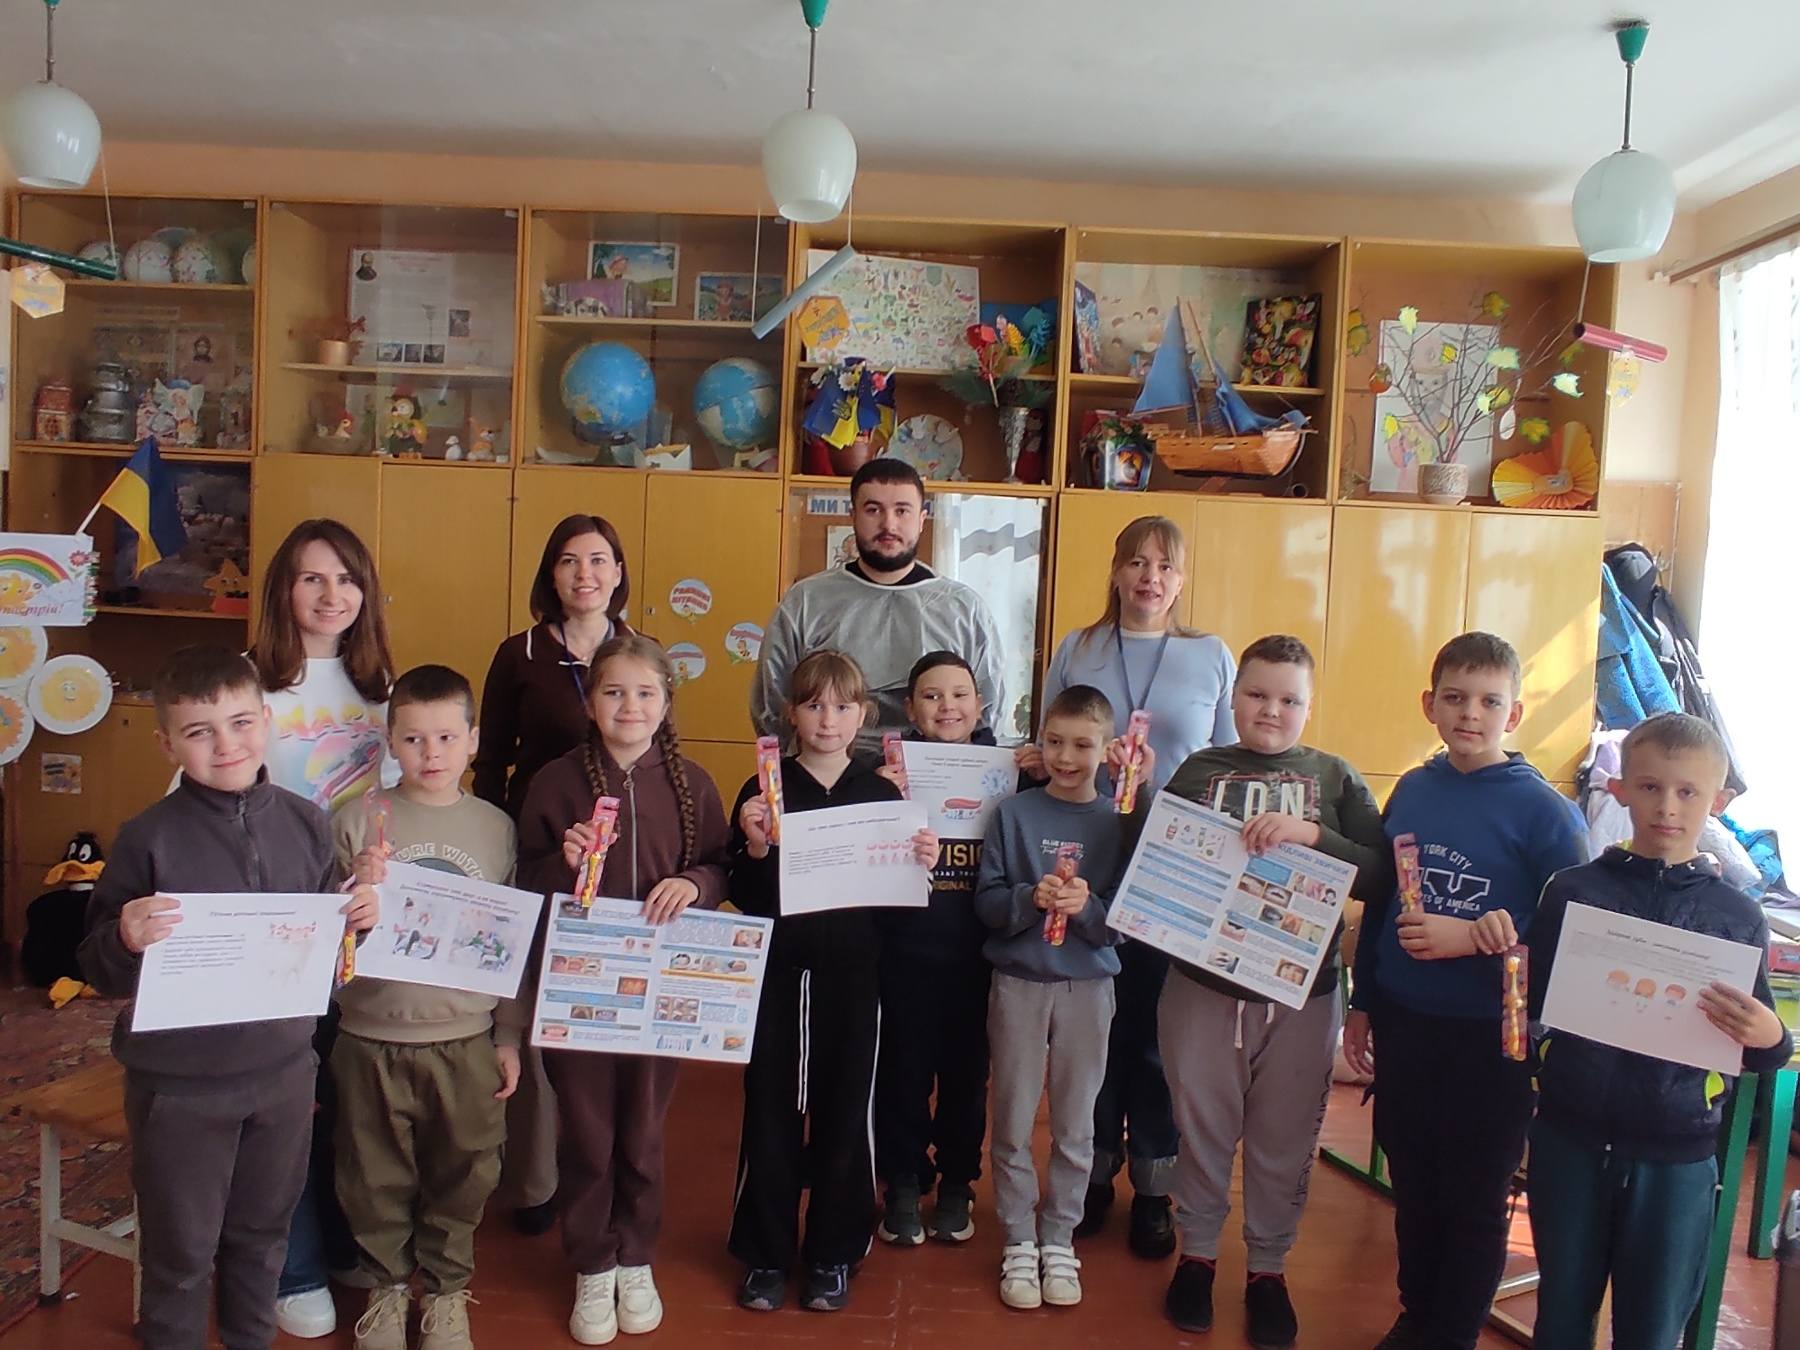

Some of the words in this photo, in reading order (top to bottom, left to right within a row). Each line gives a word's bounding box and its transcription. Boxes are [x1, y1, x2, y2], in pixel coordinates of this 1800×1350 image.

[810, 498, 837, 512] МИ
[1423, 844, 1448, 858] YORK
[1449, 851, 1472, 870] CITY
[1434, 896, 1444, 905] OF
[1446, 898, 1481, 912] AMERICA
